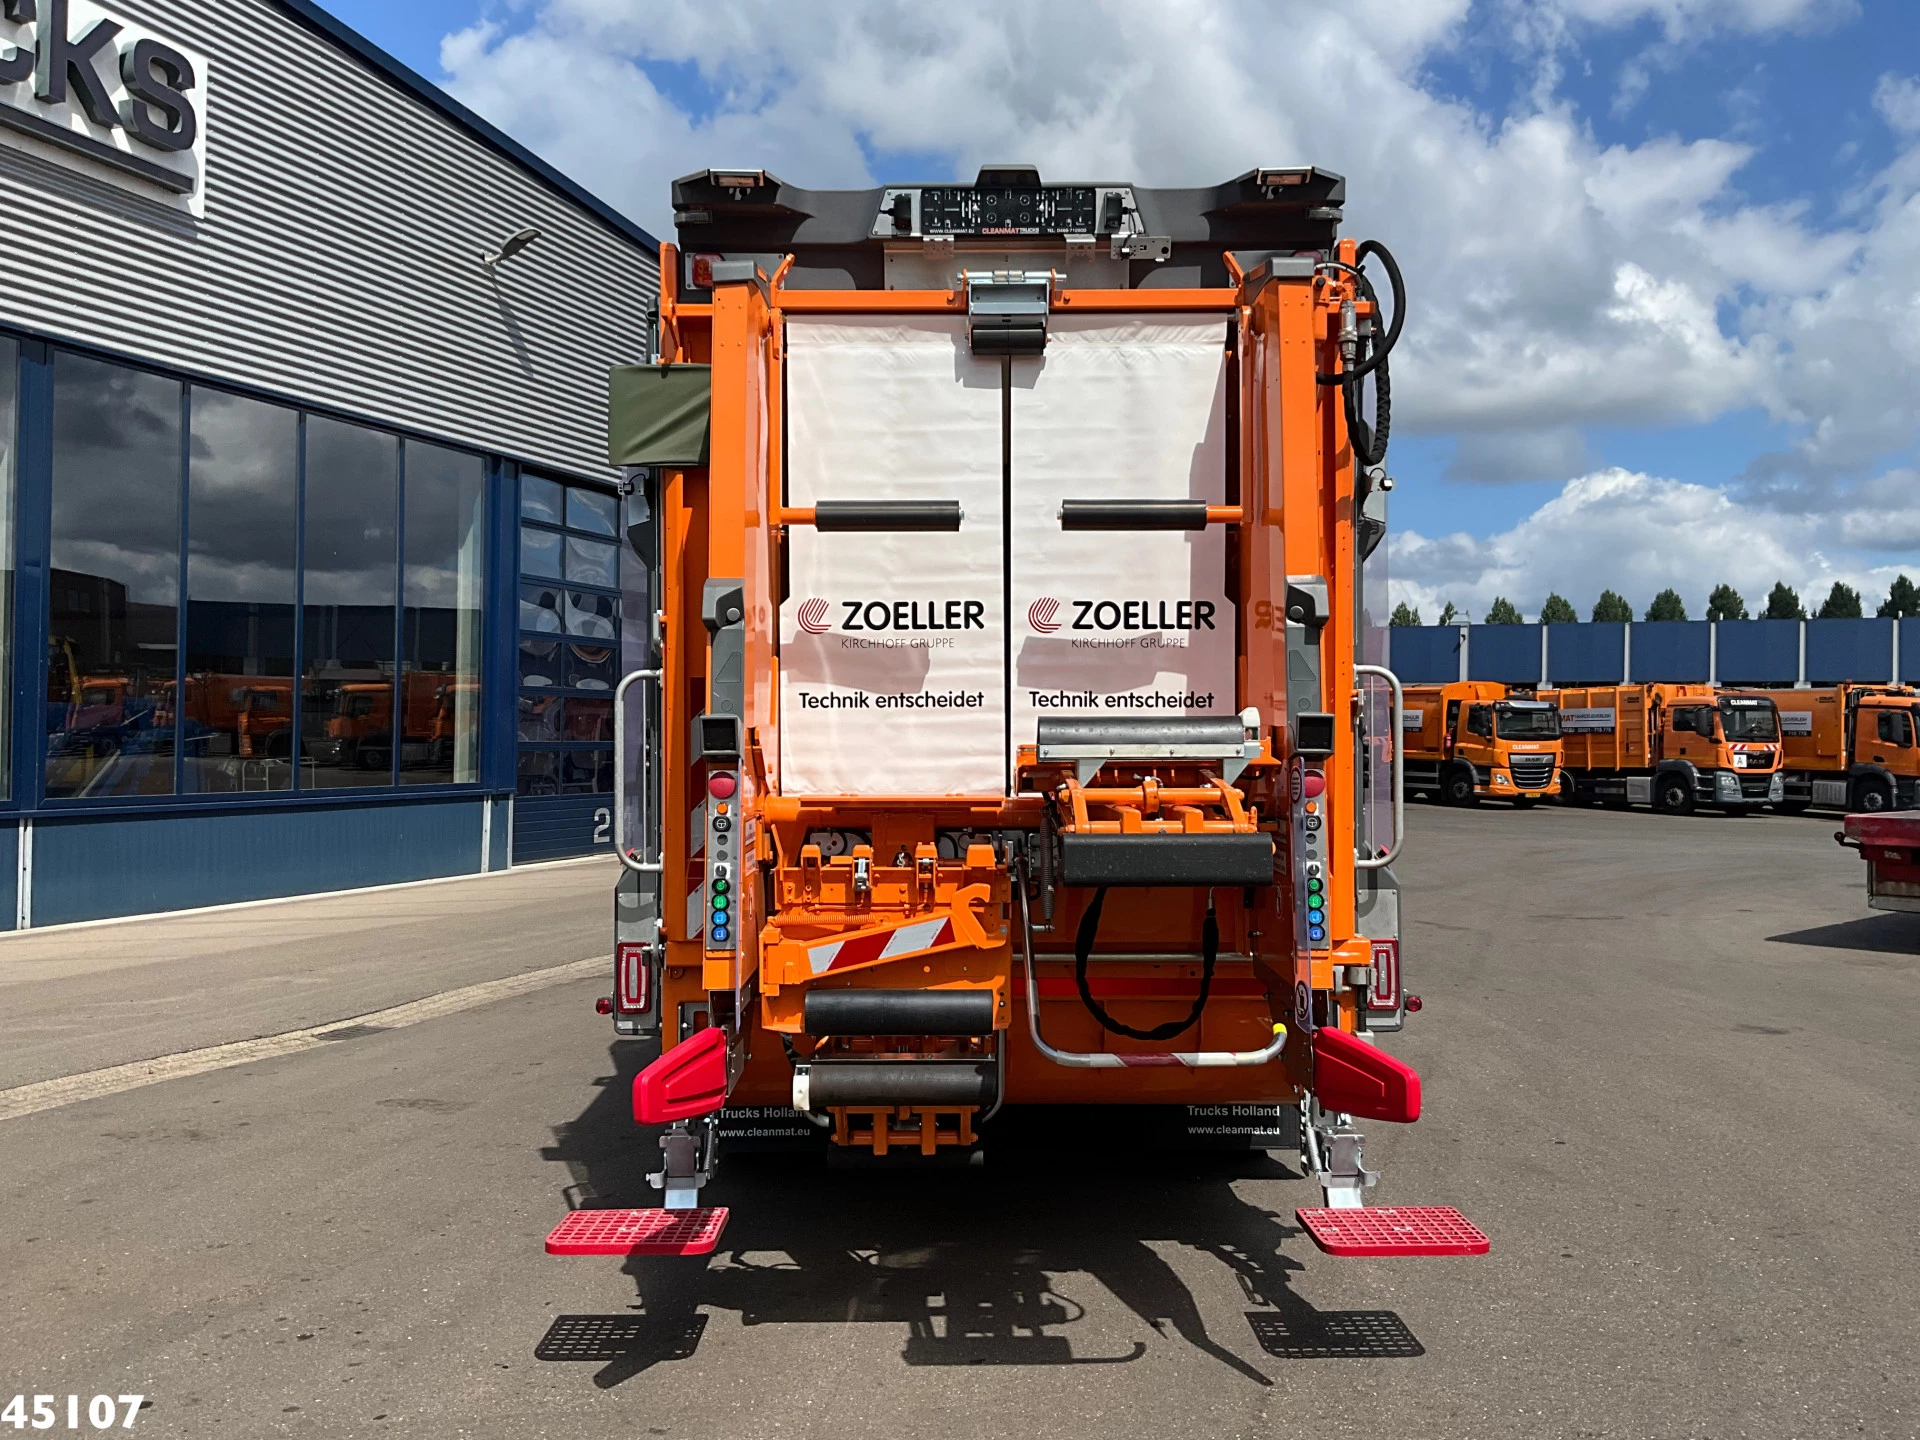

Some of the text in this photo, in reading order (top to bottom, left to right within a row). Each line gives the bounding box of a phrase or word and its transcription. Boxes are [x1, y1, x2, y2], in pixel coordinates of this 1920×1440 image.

[841, 600, 985, 631] ZOELLER
[1071, 600, 1216, 630] ZOELLER
[841, 637, 955, 649] KIRCHHOFF GRUPPE
[1071, 637, 1185, 649] KIRCHHOFF GRUPPE
[799, 690, 985, 709] Technik entscheidet
[1029, 690, 1215, 709] Technik entscheidet
[1736, 755, 1744, 765] A
[593, 807, 611, 844] 2
[719, 1107, 806, 1119] Trucks Hollan
[1187, 1105, 1280, 1117] Trucks Holland
[719, 1127, 811, 1137] www.cleanmat.eu
[1188, 1125, 1280, 1135] www.cleanmat.eu
